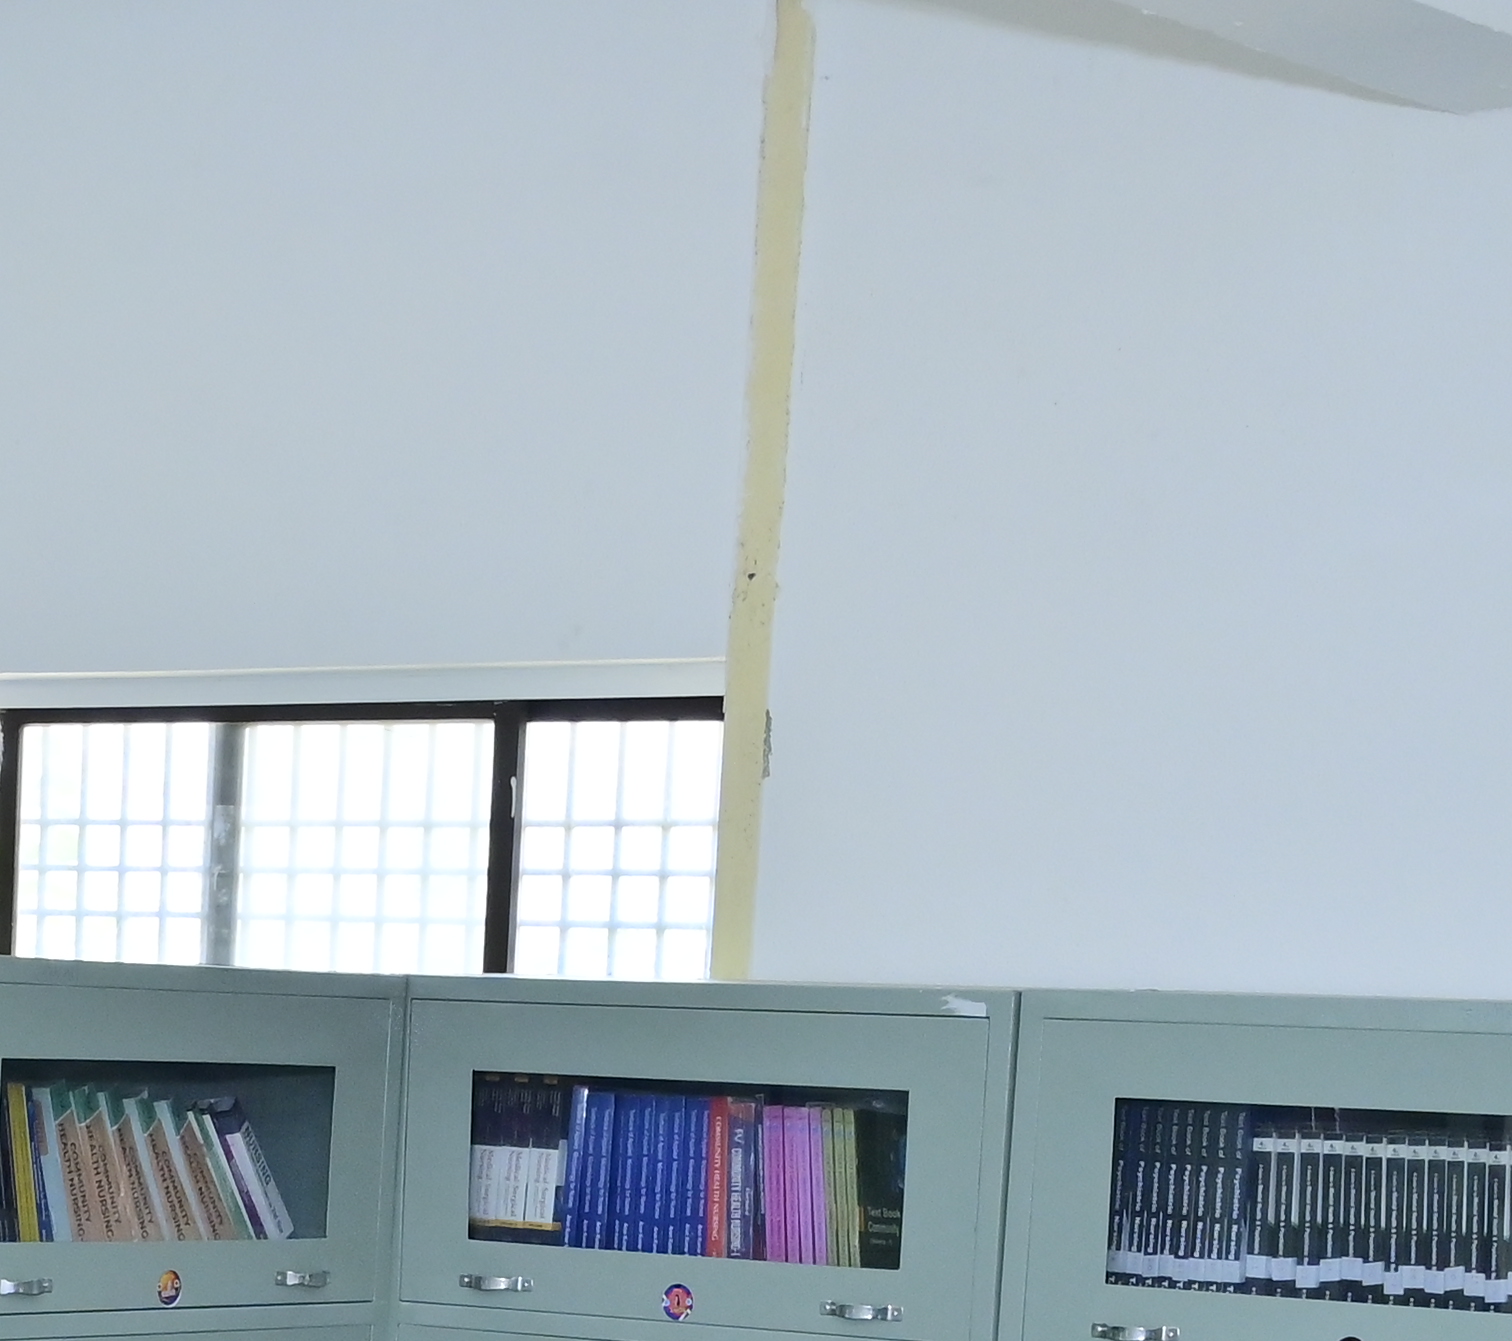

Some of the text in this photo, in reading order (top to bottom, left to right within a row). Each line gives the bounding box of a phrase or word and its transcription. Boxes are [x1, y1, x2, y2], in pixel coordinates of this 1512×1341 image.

[58, 1123, 74, 1174] HEALTH
[70, 1142, 92, 1222] COMMUNITY
[97, 1145, 122, 1224] COMMUNITY
[244, 1127, 273, 1186] NURSING
[711, 1116, 722, 1240] COMMUNITY HEALTH NURSING
[1211, 1167, 1225, 1259] Psychiatric Nursing
[1228, 1168, 1242, 1260] Psychiatric Nursing
